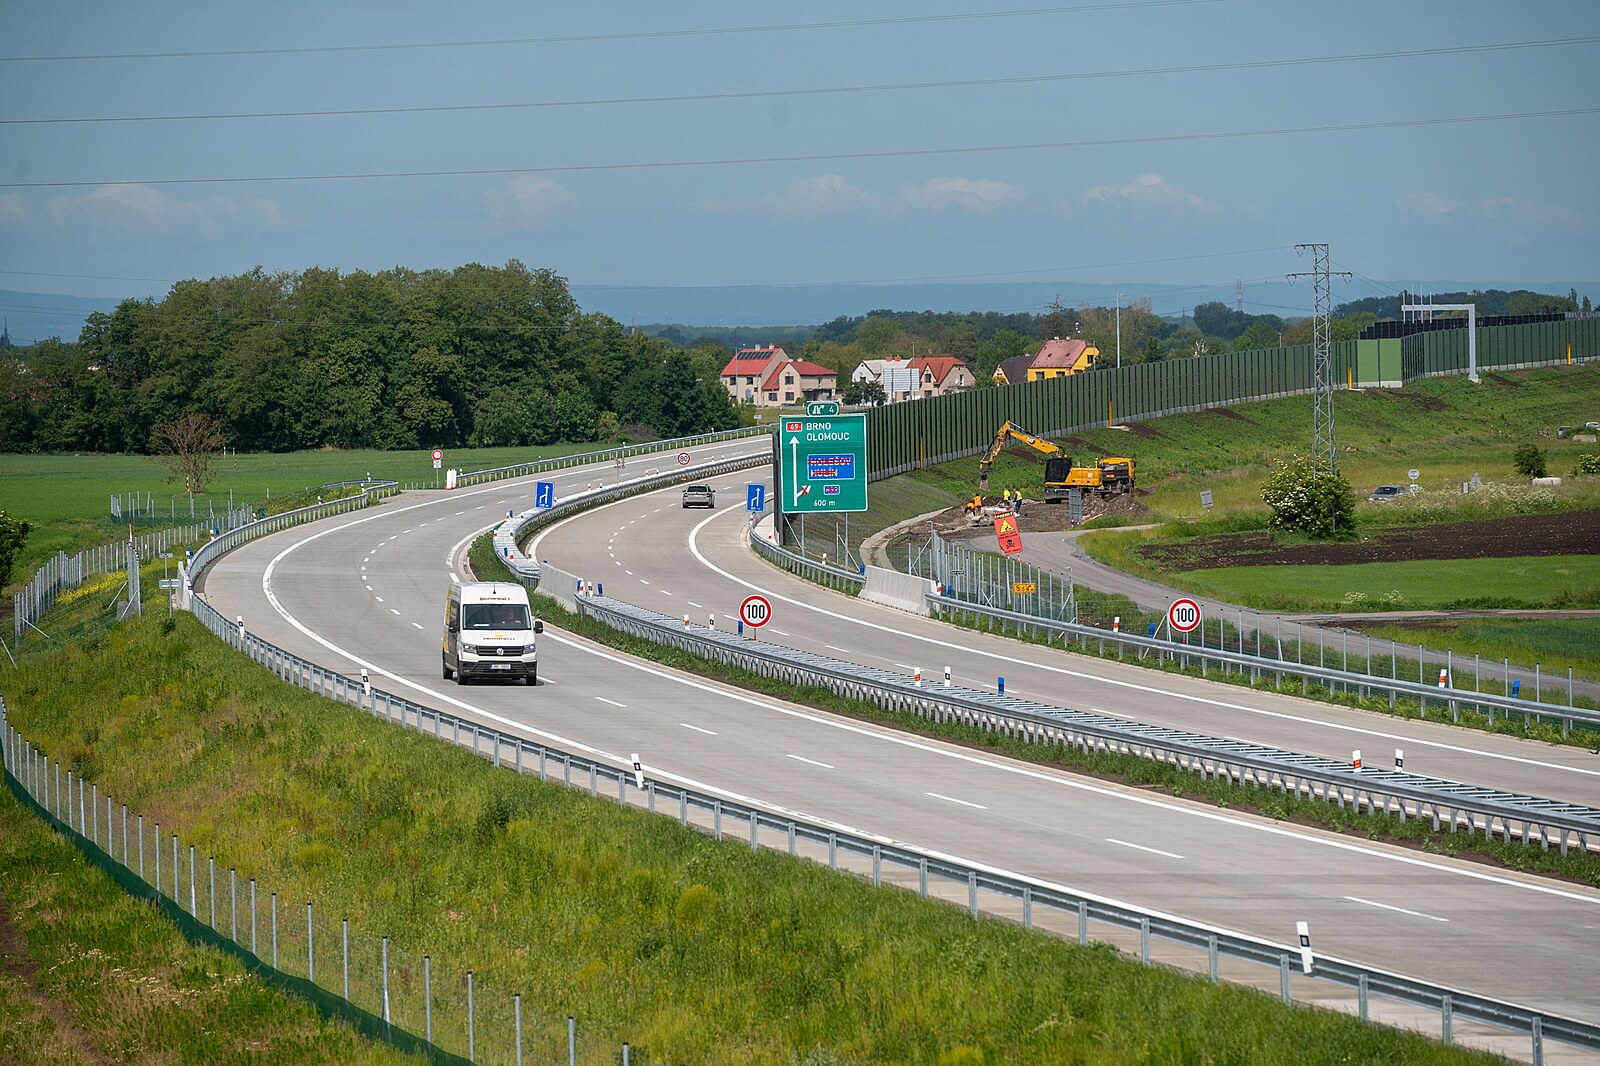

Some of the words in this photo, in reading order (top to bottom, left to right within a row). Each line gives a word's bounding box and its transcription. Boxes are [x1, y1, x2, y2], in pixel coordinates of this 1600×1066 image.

[806, 432, 850, 441] OLOMOUC
[813, 499, 826, 507] 600
[746, 604, 765, 619] 100
[1175, 608, 1194, 622] 100
